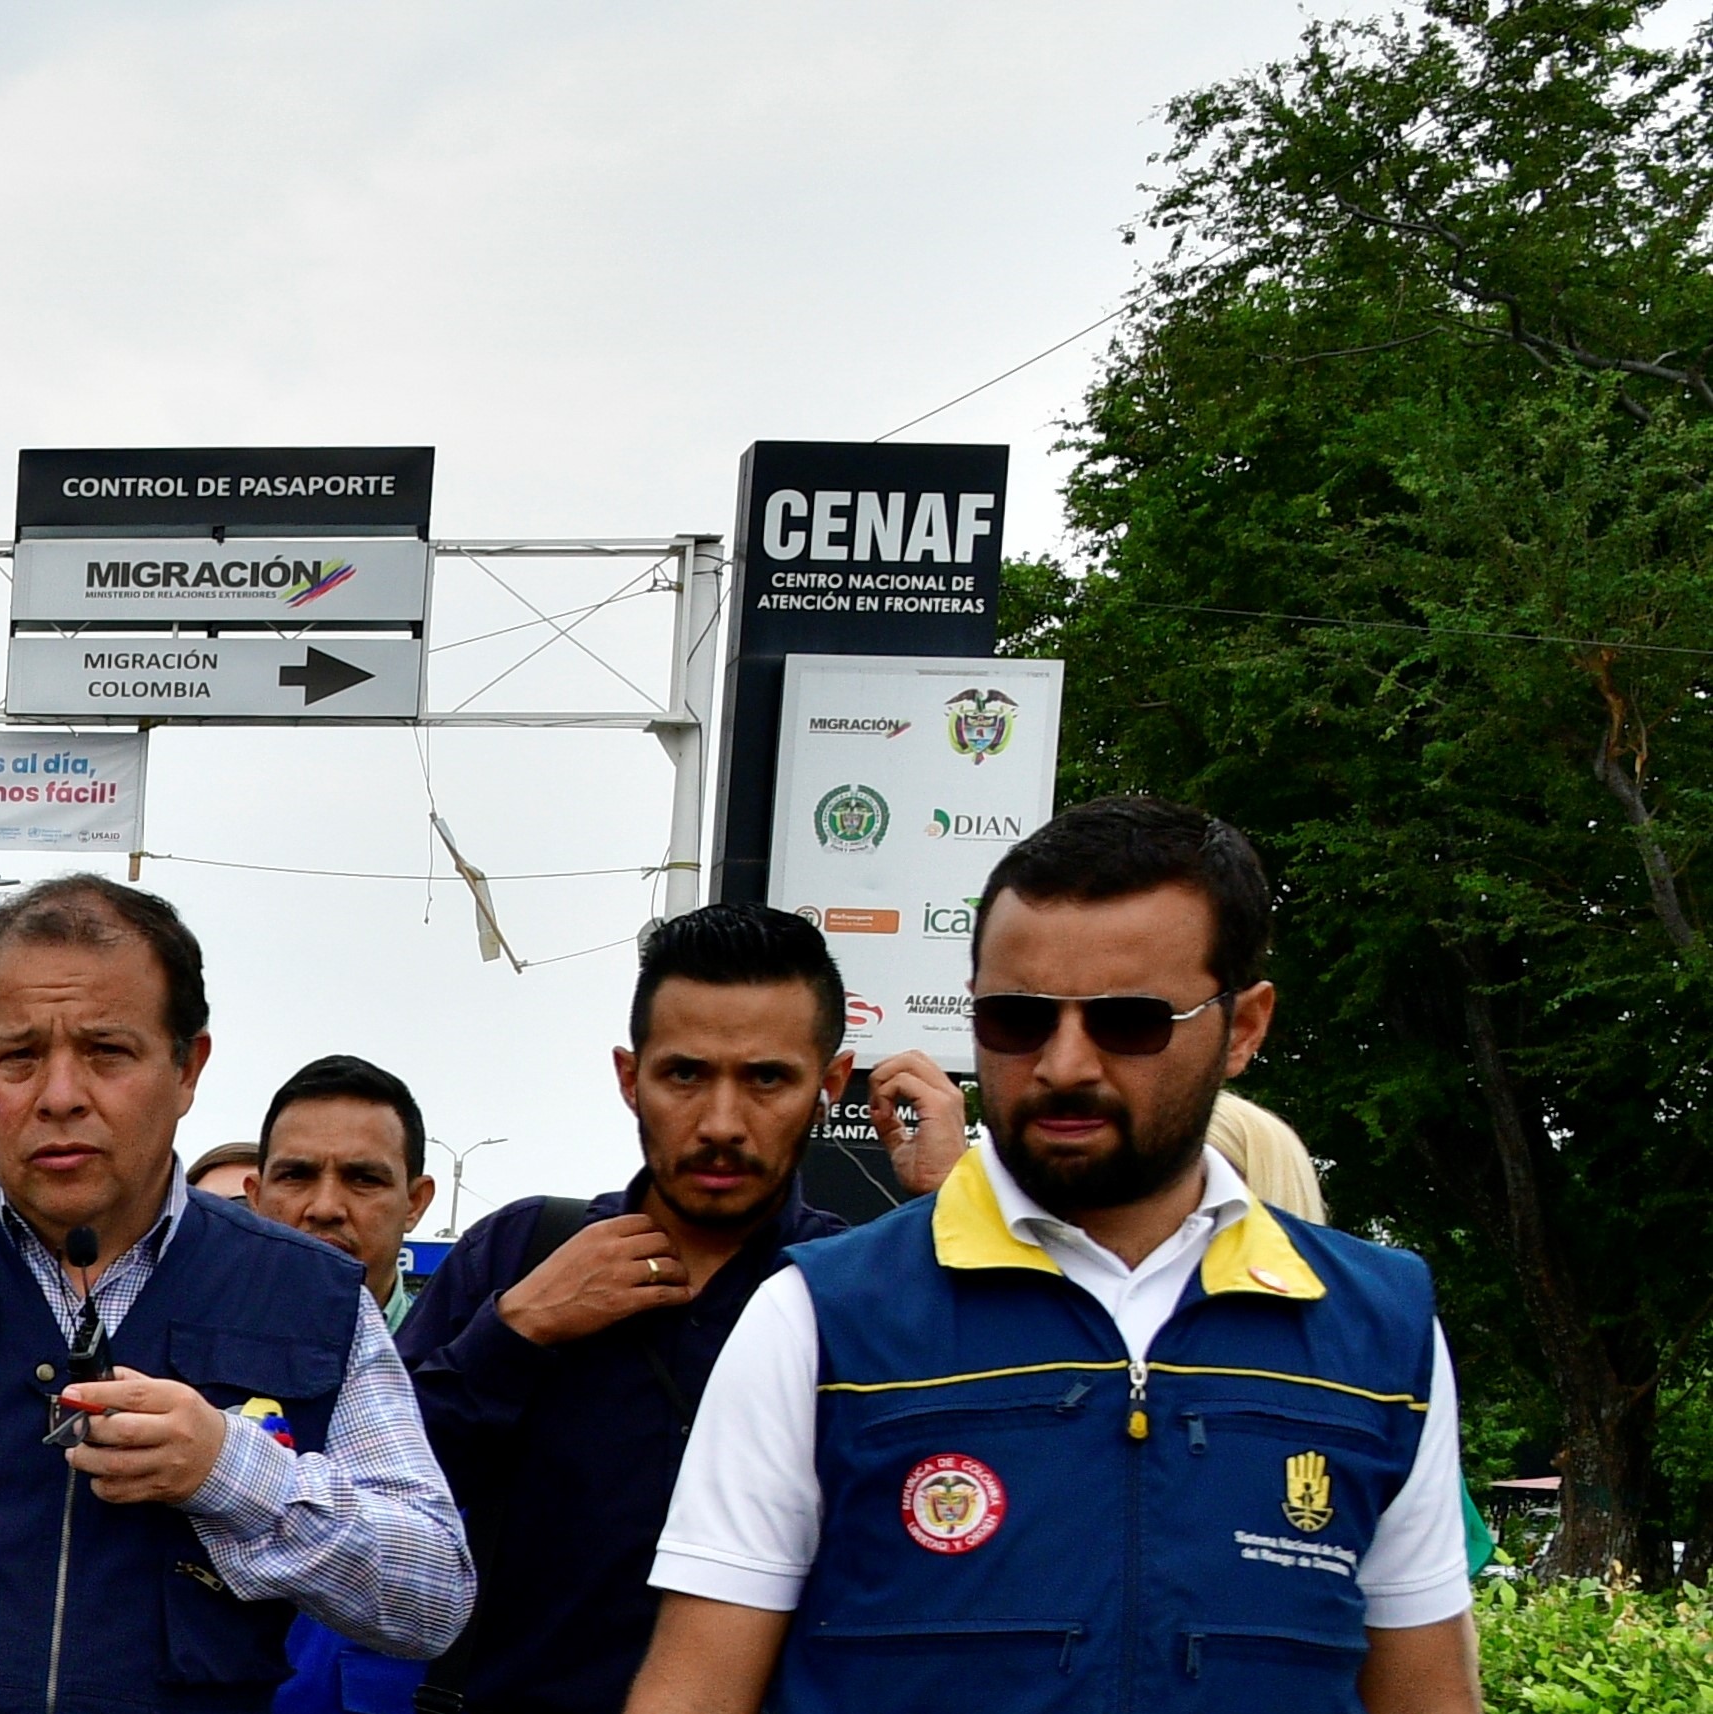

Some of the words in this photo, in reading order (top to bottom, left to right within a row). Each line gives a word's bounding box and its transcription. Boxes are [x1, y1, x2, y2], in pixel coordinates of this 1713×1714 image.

[62, 477, 190, 498] CONTROL
[197, 477, 231, 497] DE
[239, 475, 396, 497] PASAPORTE
[763, 489, 995, 563] CENAF
[85, 554, 322, 588] MIGRACIÓN
[772, 573, 843, 589] CENTRO
[848, 574, 947, 590] NACIONAL
[951, 576, 975, 591] DE
[84, 591, 140, 599] MINISTERIO
[142, 591, 156, 599] DE
[158, 591, 217, 599] RELACIONES
[219, 591, 277, 599] EXTERIORES
[757, 591, 851, 611] ATENCIÓN
[856, 596, 879, 612] EN
[884, 597, 985, 614] FRONTERAS
[83, 648, 218, 670] MIGRACIÓN
[87, 681, 211, 699] COLOMBIA
[809, 717, 900, 732] MIGRACIÓN
[12, 753, 37, 774] al
[43, 751, 97, 778] día,
[45, 780, 117, 804] fácil!
[91, 831, 121, 840] USAID
[954, 814, 1022, 837] DIAN
[923, 902, 972, 934] ica
[904, 994, 973, 1006] ALCALDÍA
[937, 1457, 955, 1468] DE
[961, 1460, 1001, 1507] COLOMBIA
[952, 1540, 964, 1550] Y
[965, 1513, 998, 1545] ORDEN
